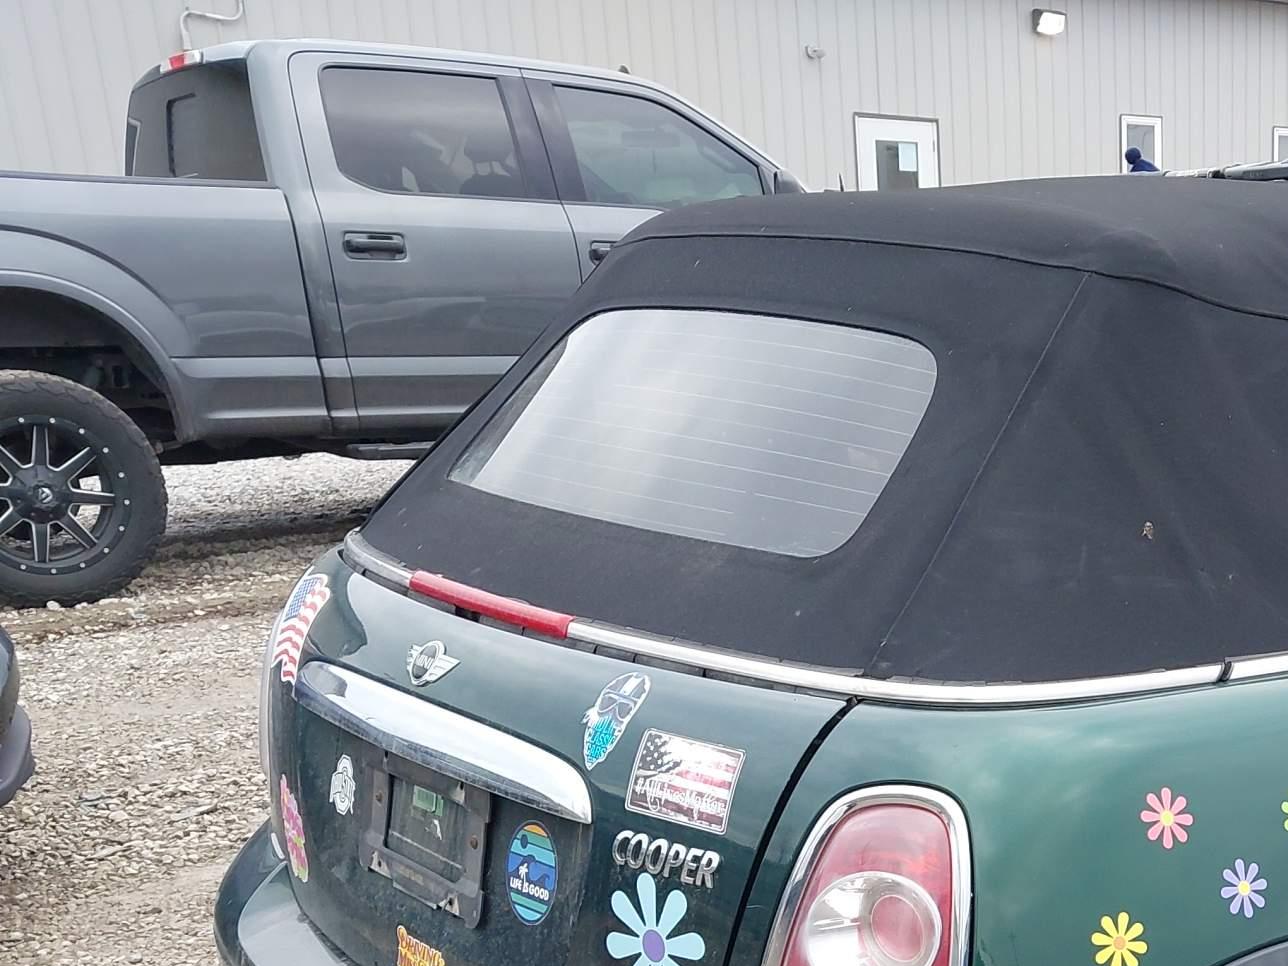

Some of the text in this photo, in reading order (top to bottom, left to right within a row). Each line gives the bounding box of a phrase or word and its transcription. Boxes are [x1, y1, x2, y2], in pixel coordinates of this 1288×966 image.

[415, 653, 436, 671] MINI
[612, 830, 720, 889] COOPER
[528, 884, 550, 900] GOOD
